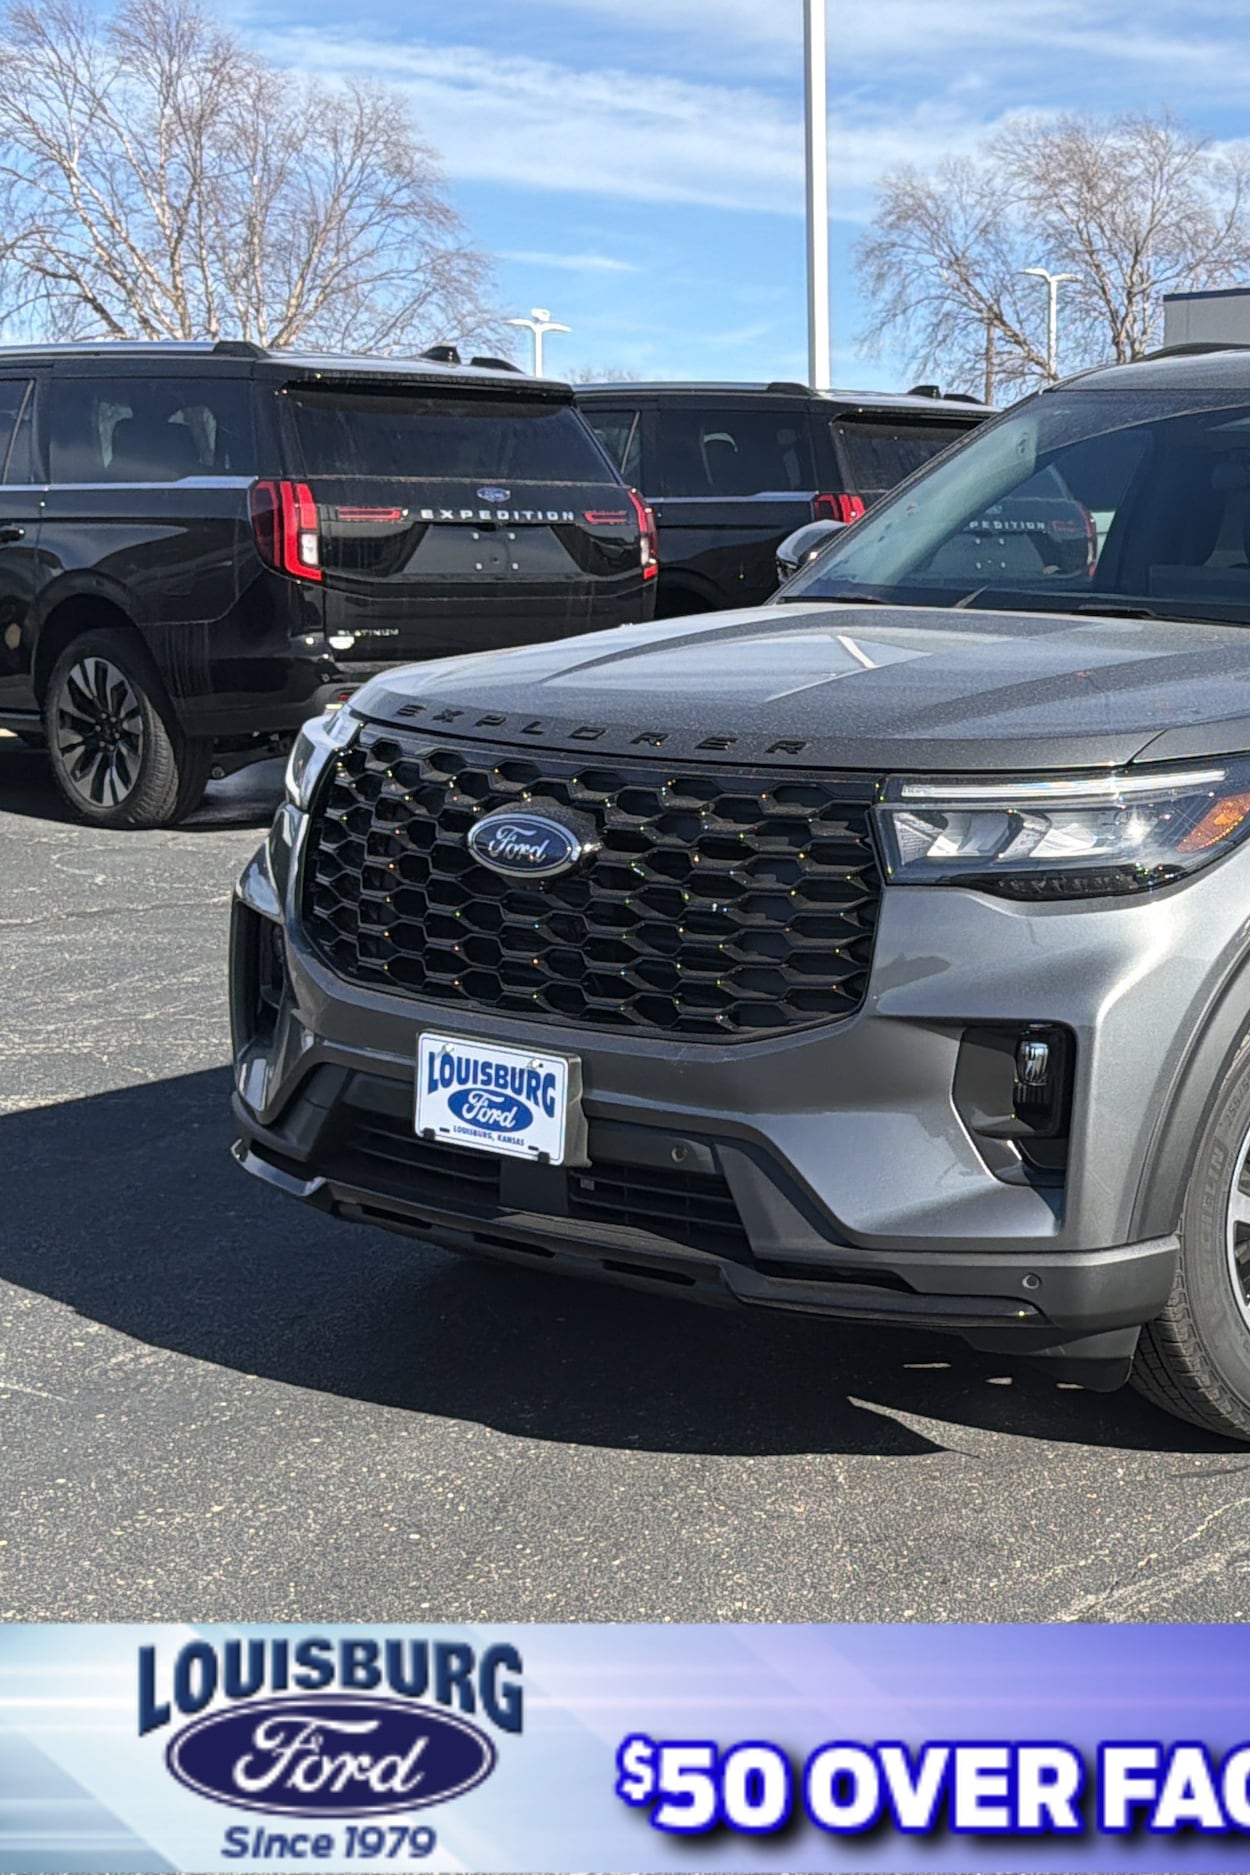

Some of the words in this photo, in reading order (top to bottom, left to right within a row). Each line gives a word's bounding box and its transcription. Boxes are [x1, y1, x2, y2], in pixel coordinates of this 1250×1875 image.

[420, 509, 575, 520] EXPEDITION
[968, 520, 1046, 530] PEDITION
[394, 703, 809, 755] EXPLORER
[488, 825, 550, 863] Ford
[428, 1051, 556, 1119] LOUISBURG
[462, 1090, 518, 1129] Ford
[453, 1125, 495, 1142] LOUISBURG,
[497, 1133, 525, 1147] KANSAS
